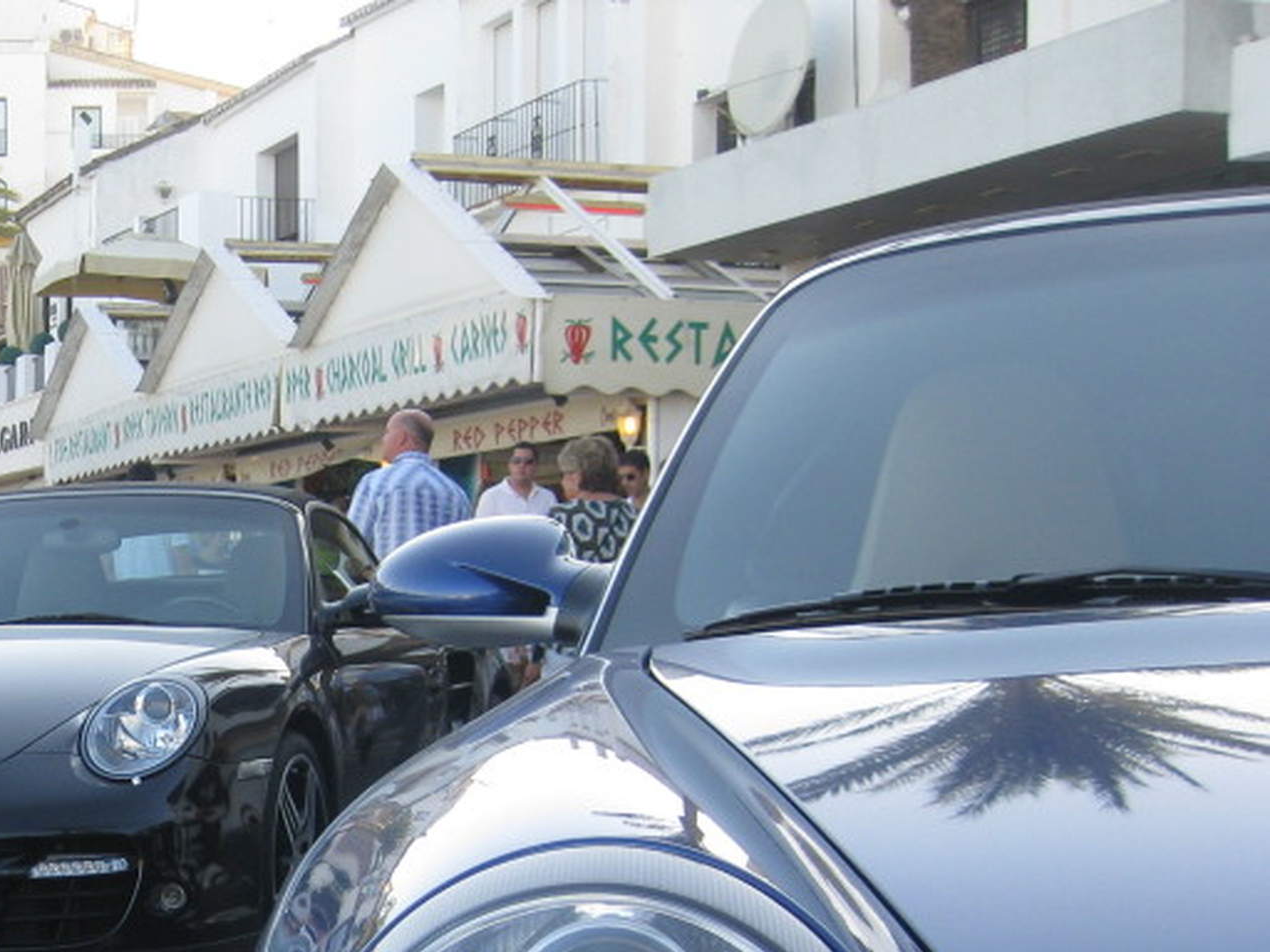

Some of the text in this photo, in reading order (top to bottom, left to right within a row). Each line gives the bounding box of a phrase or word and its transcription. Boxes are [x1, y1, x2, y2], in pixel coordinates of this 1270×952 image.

[450, 311, 507, 365] CARNES
[611, 315, 739, 368] RESTA
[453, 410, 564, 451] RED PEPPER
